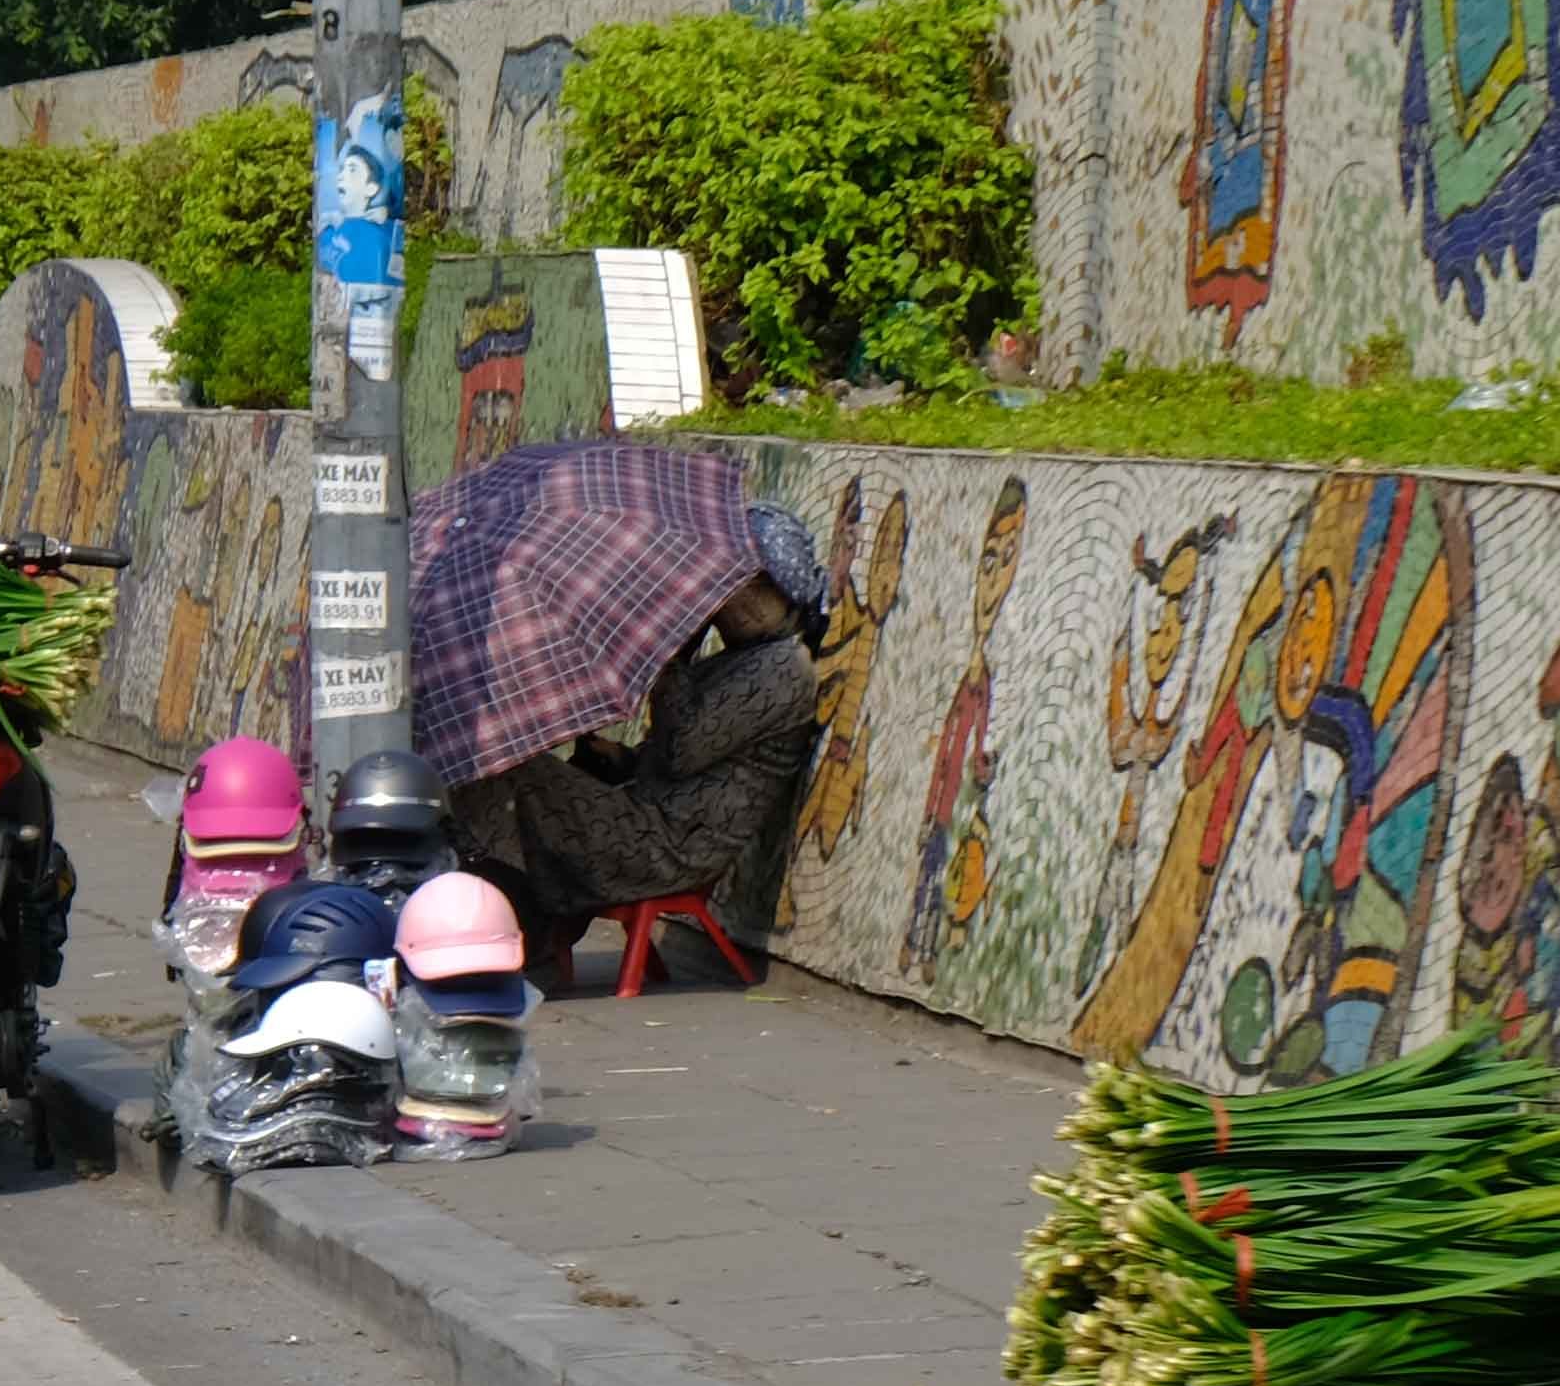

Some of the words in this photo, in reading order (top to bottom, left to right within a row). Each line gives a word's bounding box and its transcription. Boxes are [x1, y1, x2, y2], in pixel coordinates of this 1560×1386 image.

[321, 464, 339, 482] XE
[343, 460, 381, 482] MÁY
[321, 580, 340, 598] XE
[344, 576, 382, 598] MÁY
[324, 668, 344, 687] XE
[347, 661, 386, 685] MÁY
